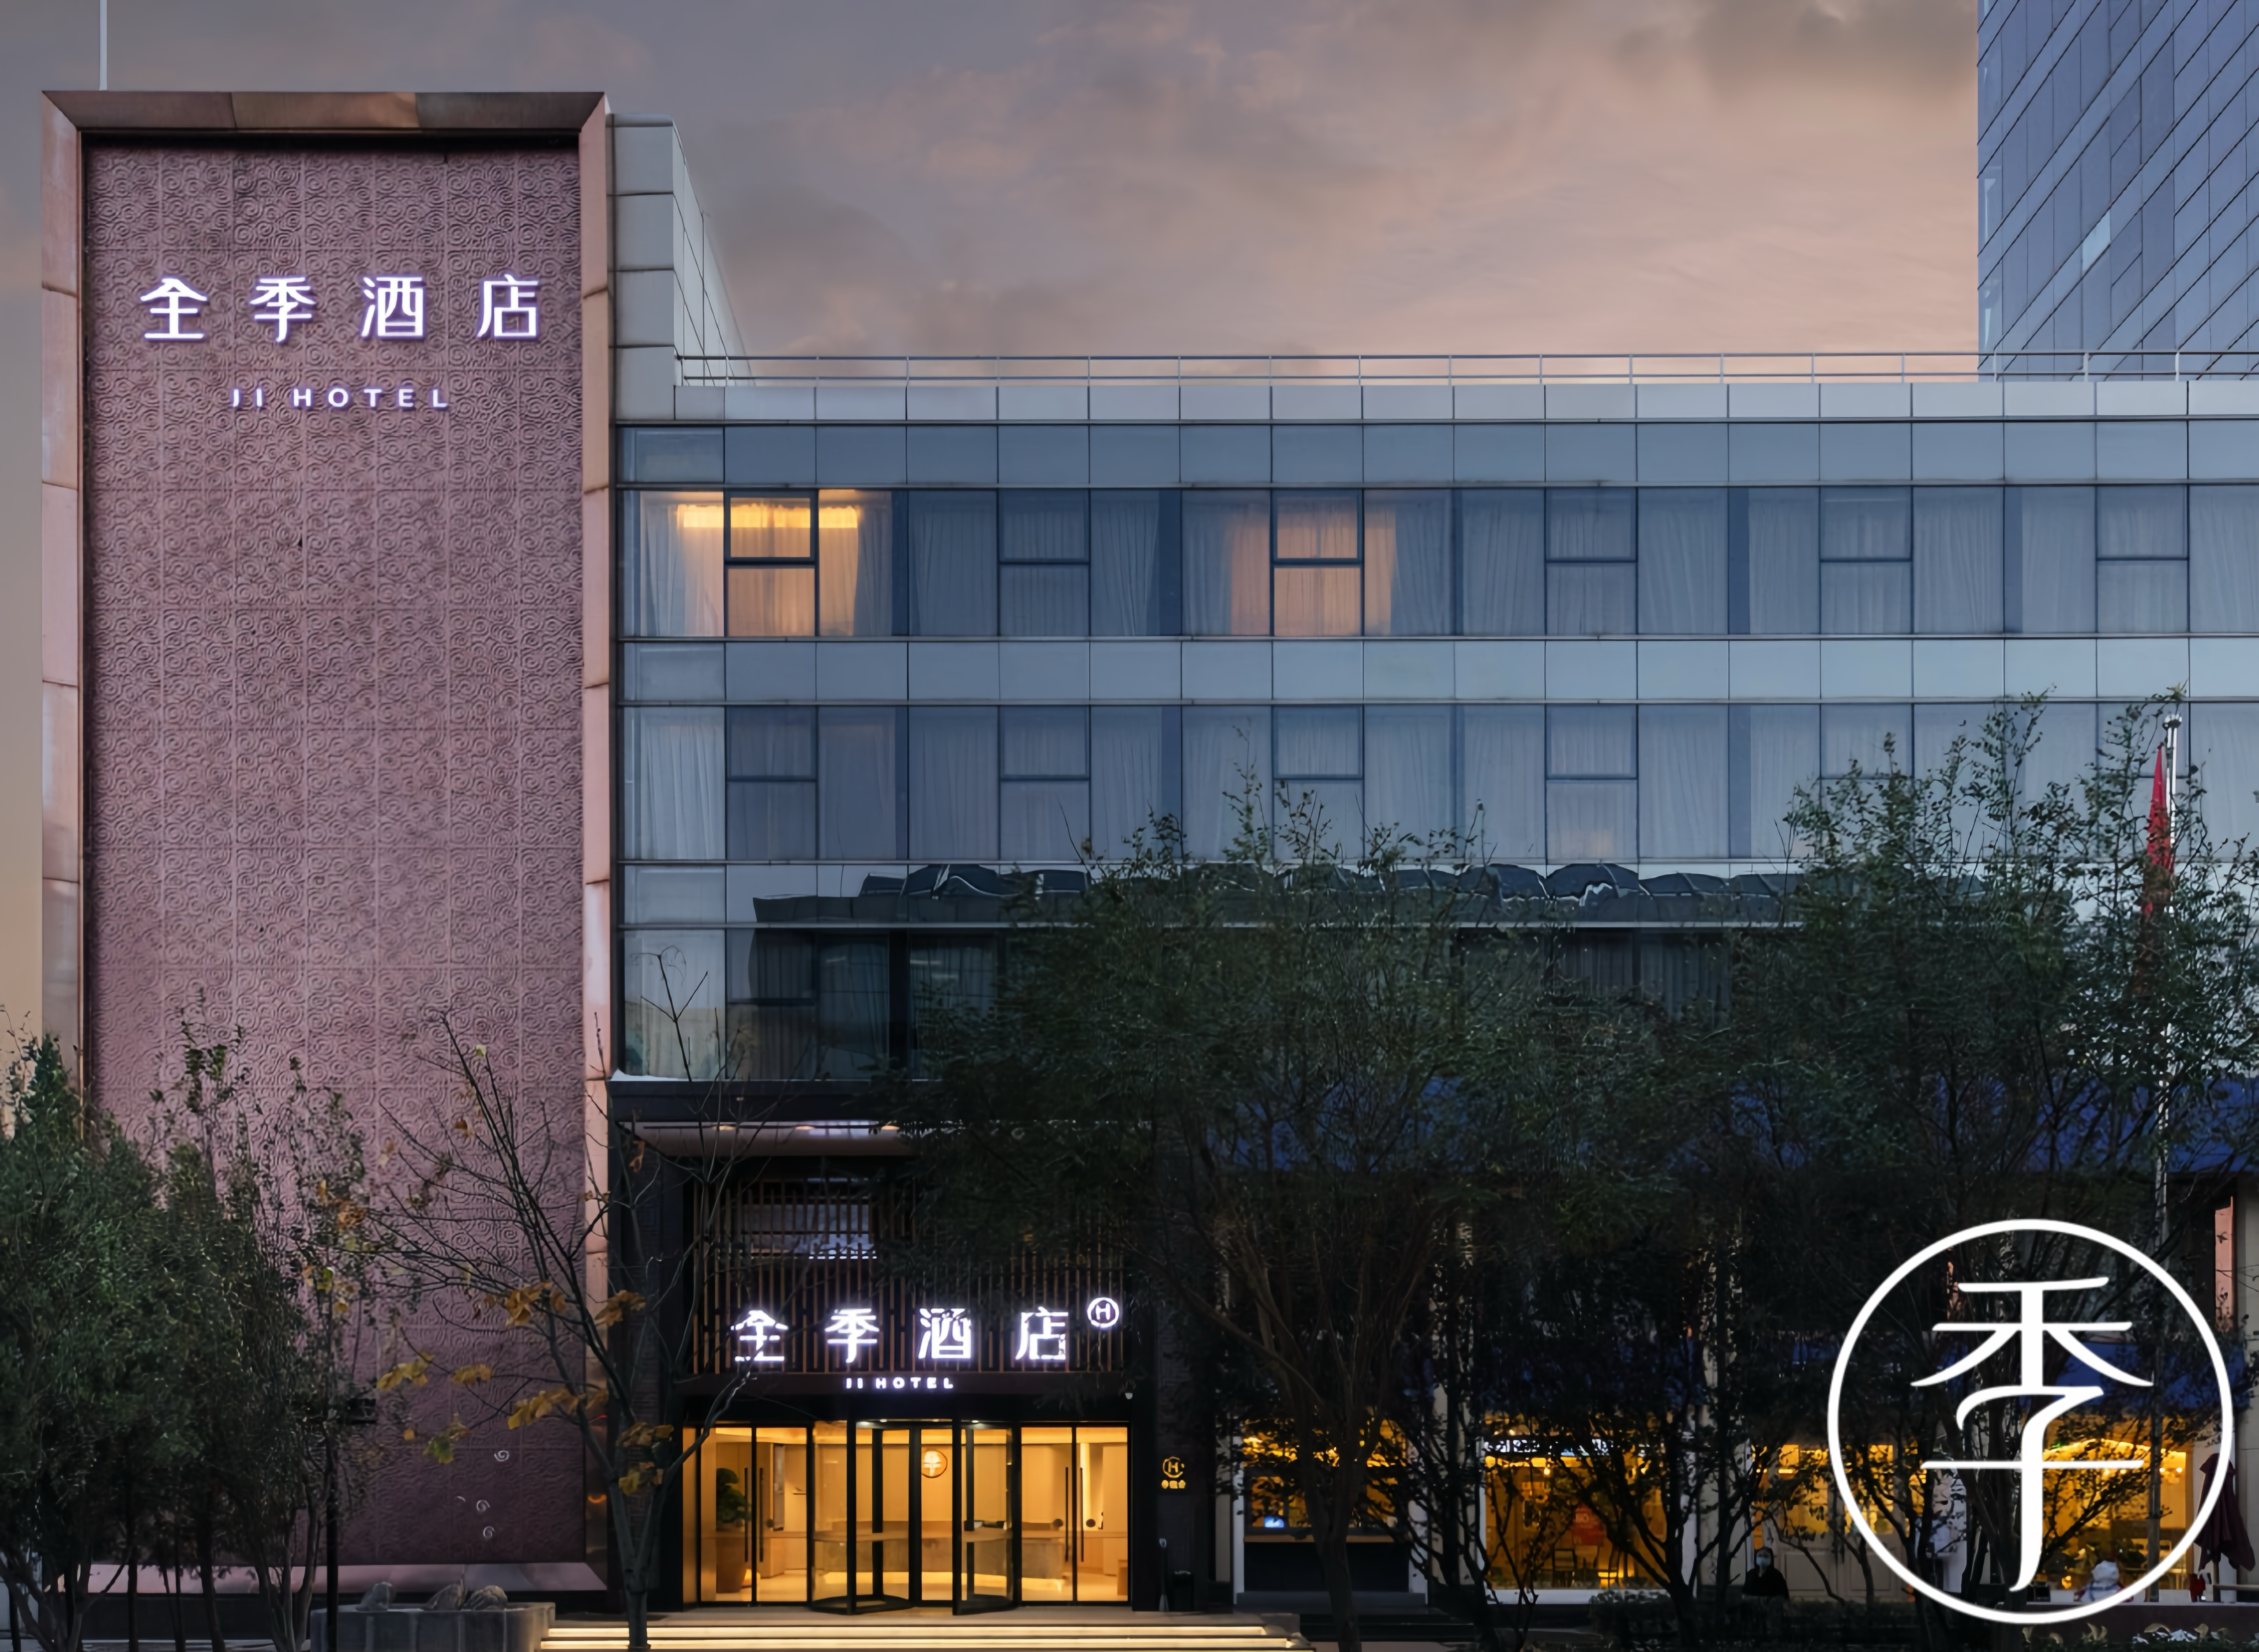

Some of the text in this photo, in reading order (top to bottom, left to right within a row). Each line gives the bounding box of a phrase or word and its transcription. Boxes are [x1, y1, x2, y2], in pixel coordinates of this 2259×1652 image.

[140, 274, 538, 342] 全季酒店
[233, 388, 447, 407] JI HOTEL
[730, 1307, 1069, 1363] 全季酒店
[875, 1377, 953, 1389] HOTEL
